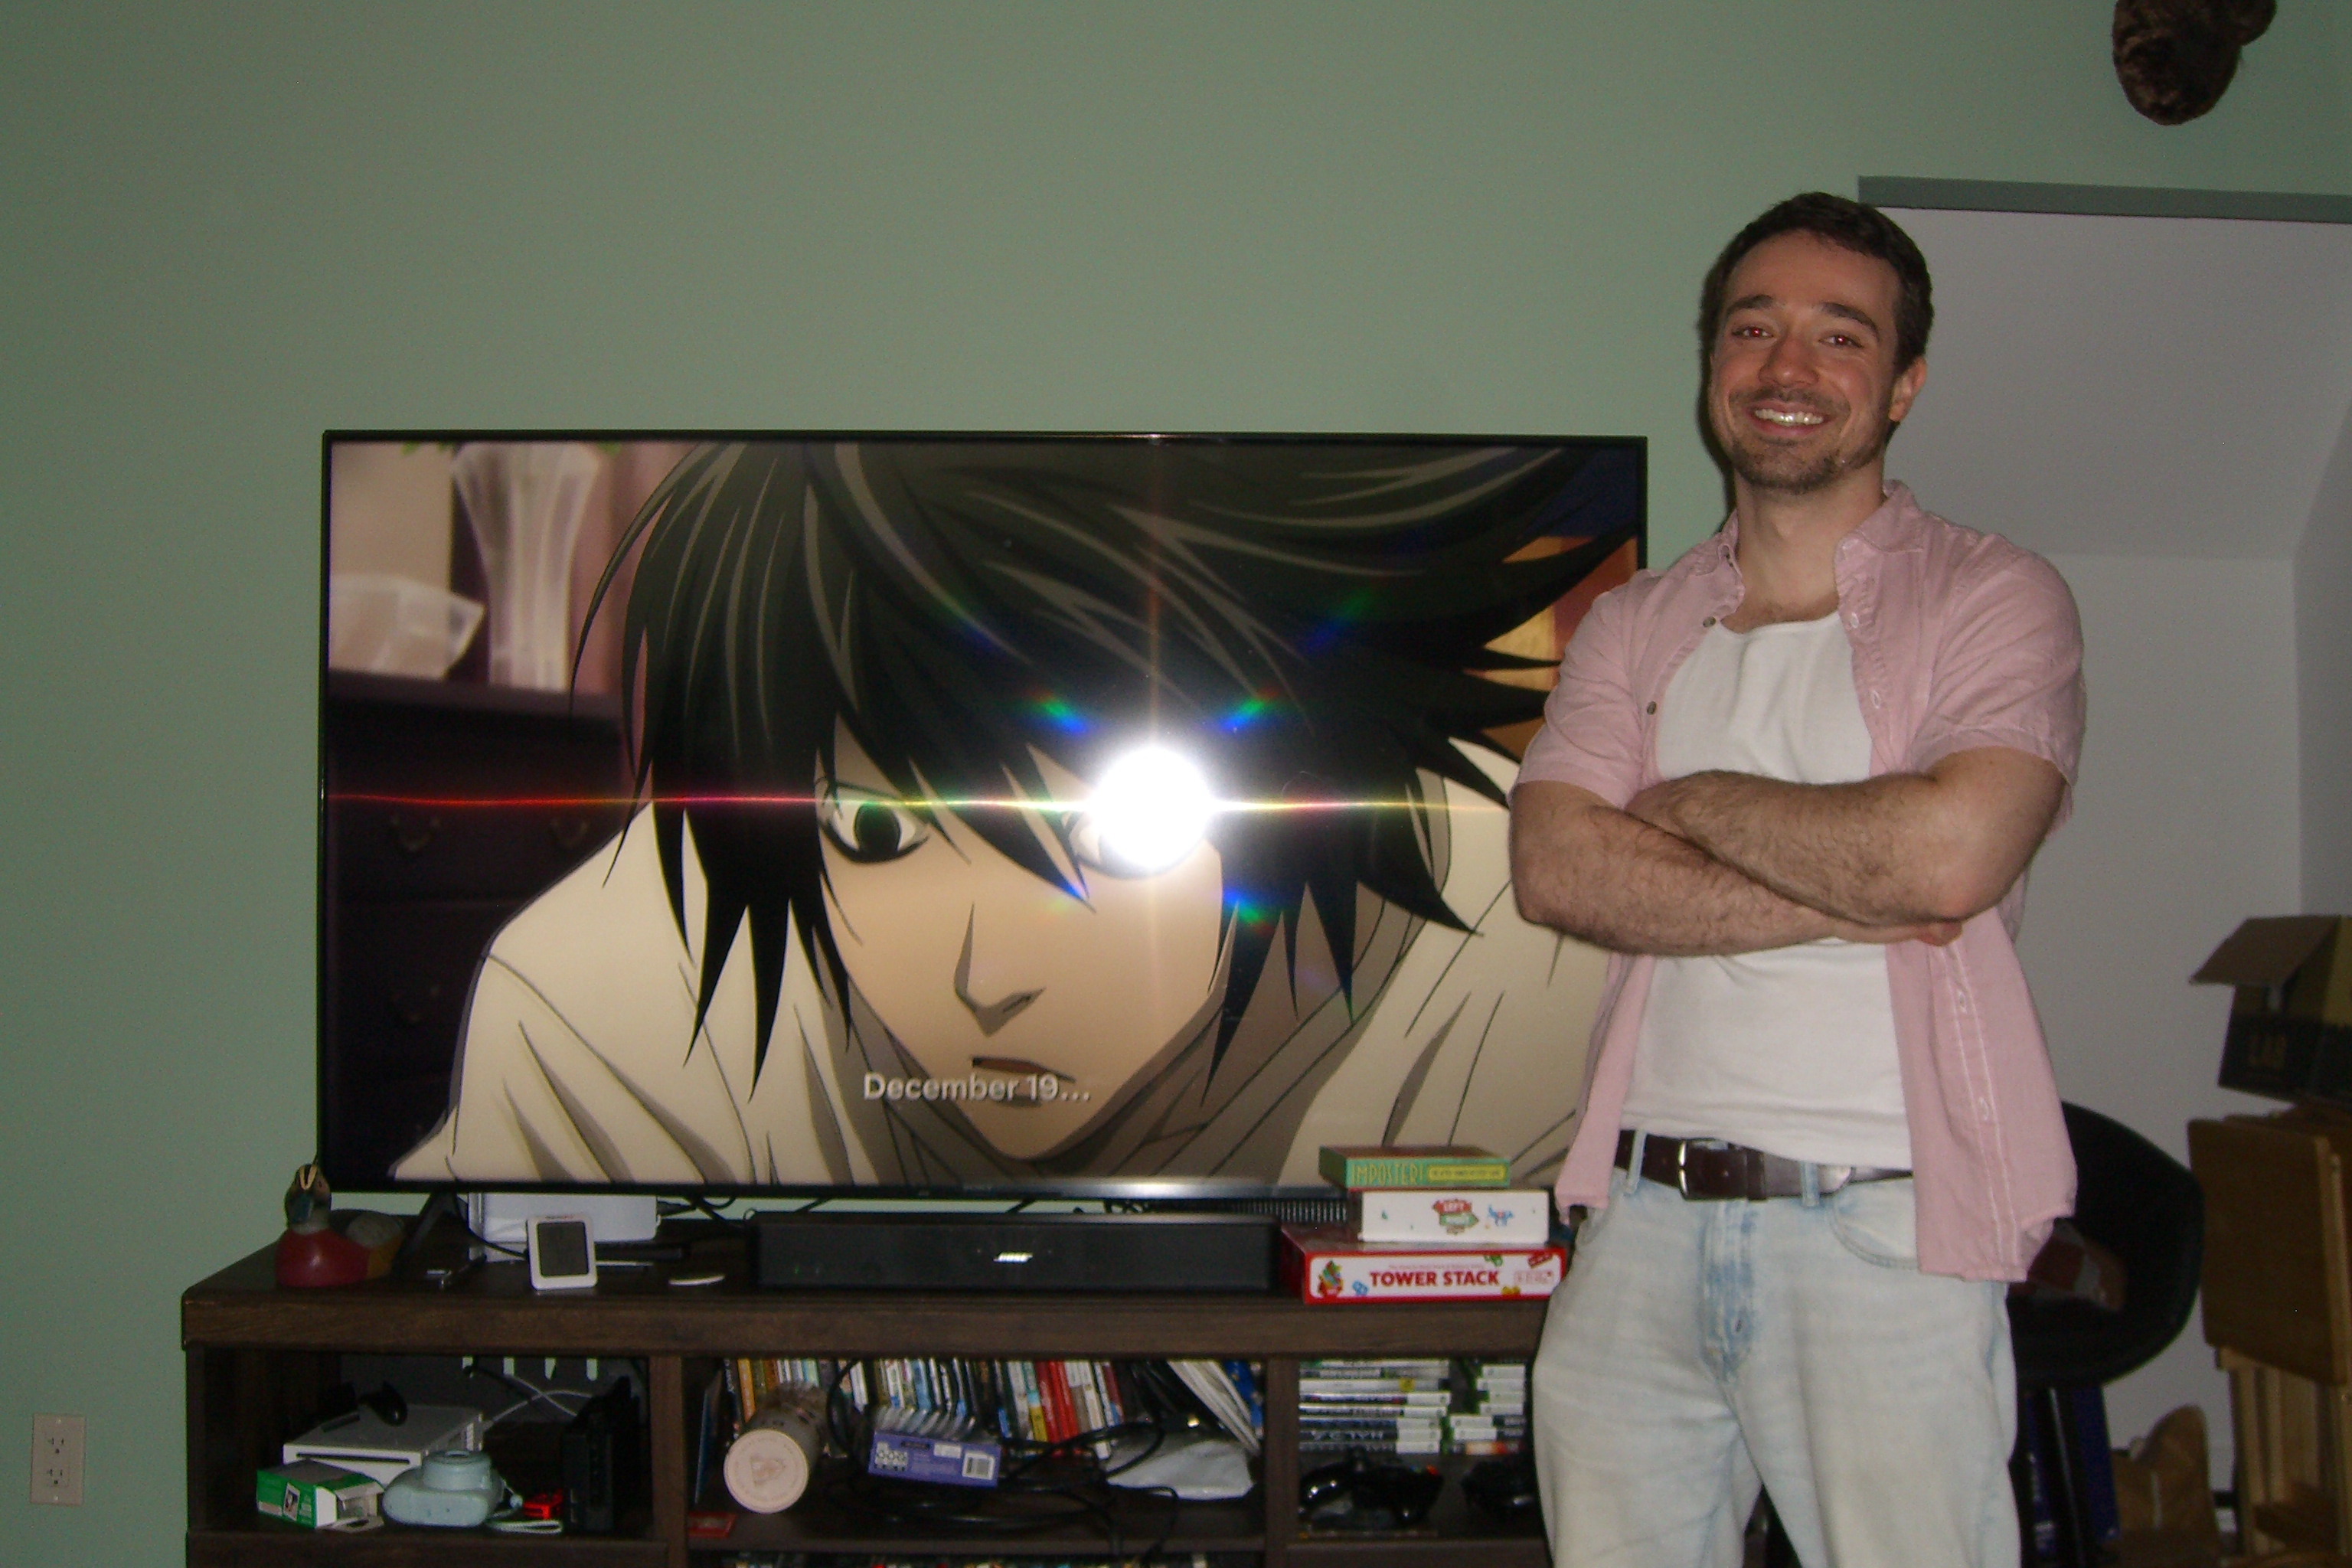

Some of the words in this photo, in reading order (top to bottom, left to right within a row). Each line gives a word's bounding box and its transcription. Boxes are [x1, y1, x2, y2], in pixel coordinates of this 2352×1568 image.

[864, 1072, 1020, 1101] December
[1027, 1073, 1091, 1102] 19...
[1370, 1270, 1438, 1287] TOWER
[1443, 1270, 1500, 1286] STACK
